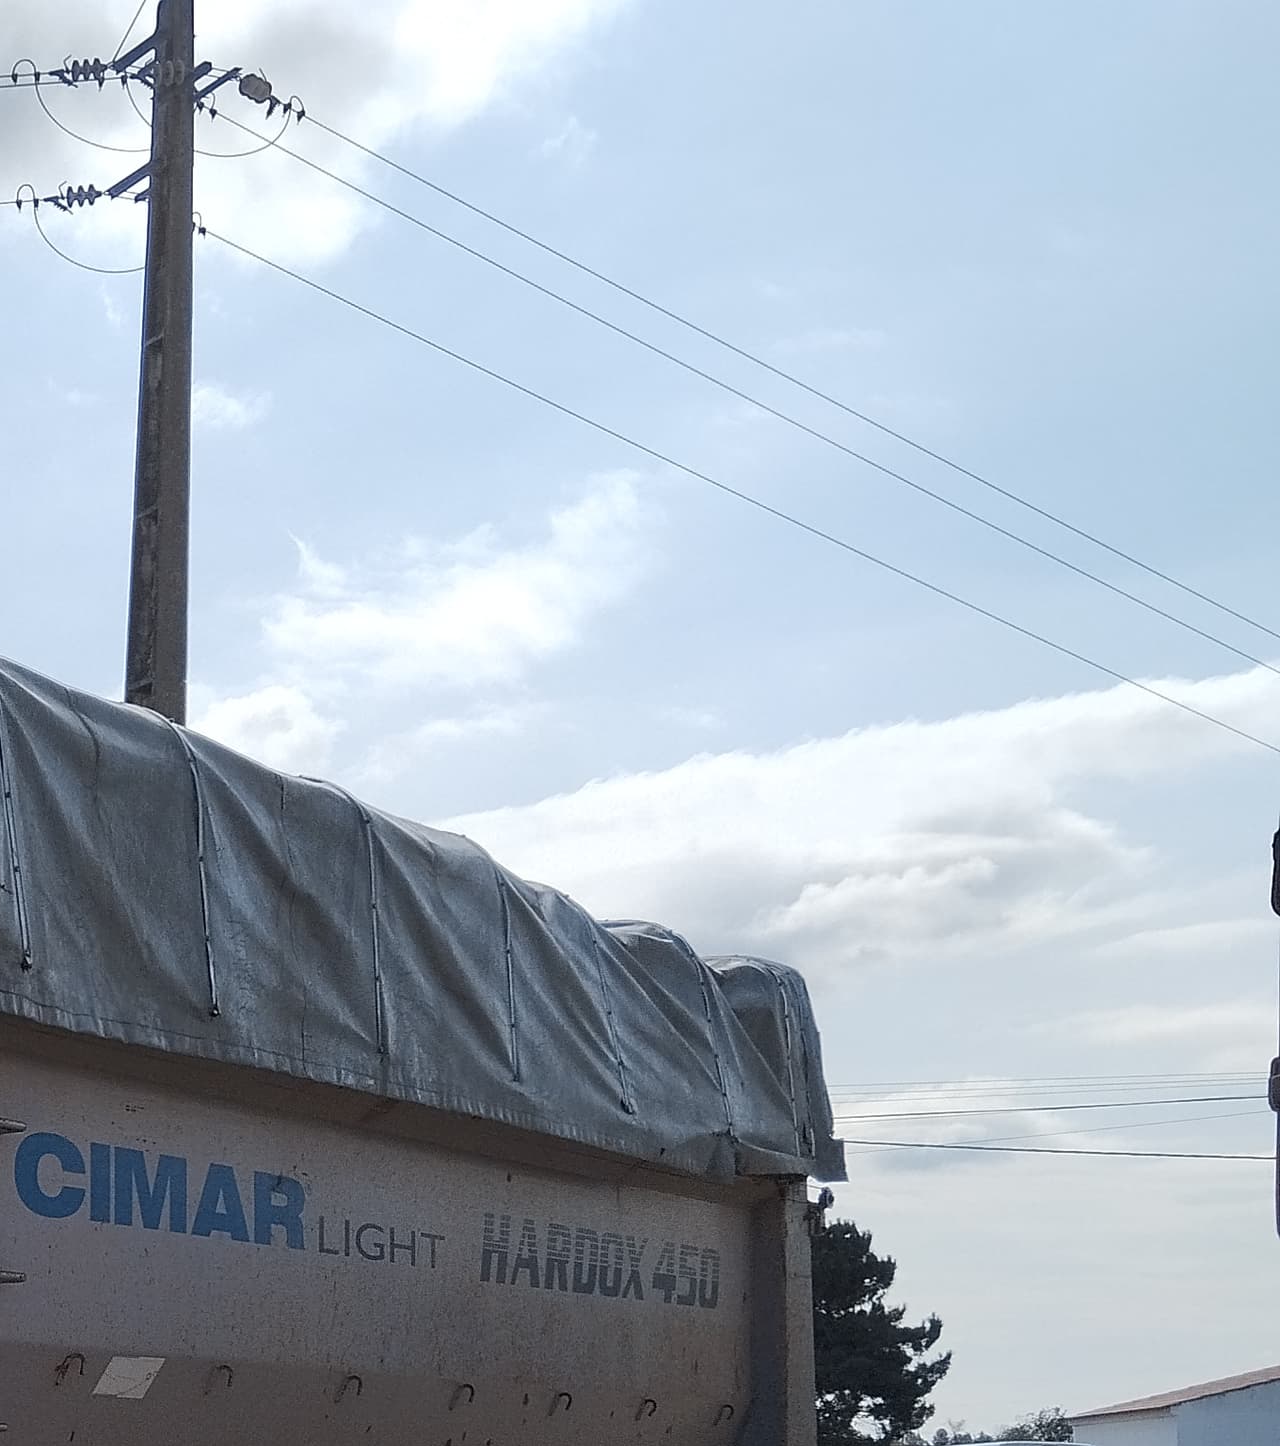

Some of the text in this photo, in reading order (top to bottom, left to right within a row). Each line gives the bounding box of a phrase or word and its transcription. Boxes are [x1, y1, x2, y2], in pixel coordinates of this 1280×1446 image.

[15, 1132, 305, 1250] CIMAR
[318, 1216, 445, 1269] LIGHT
[480, 1212, 721, 1310] HARDOX 450
